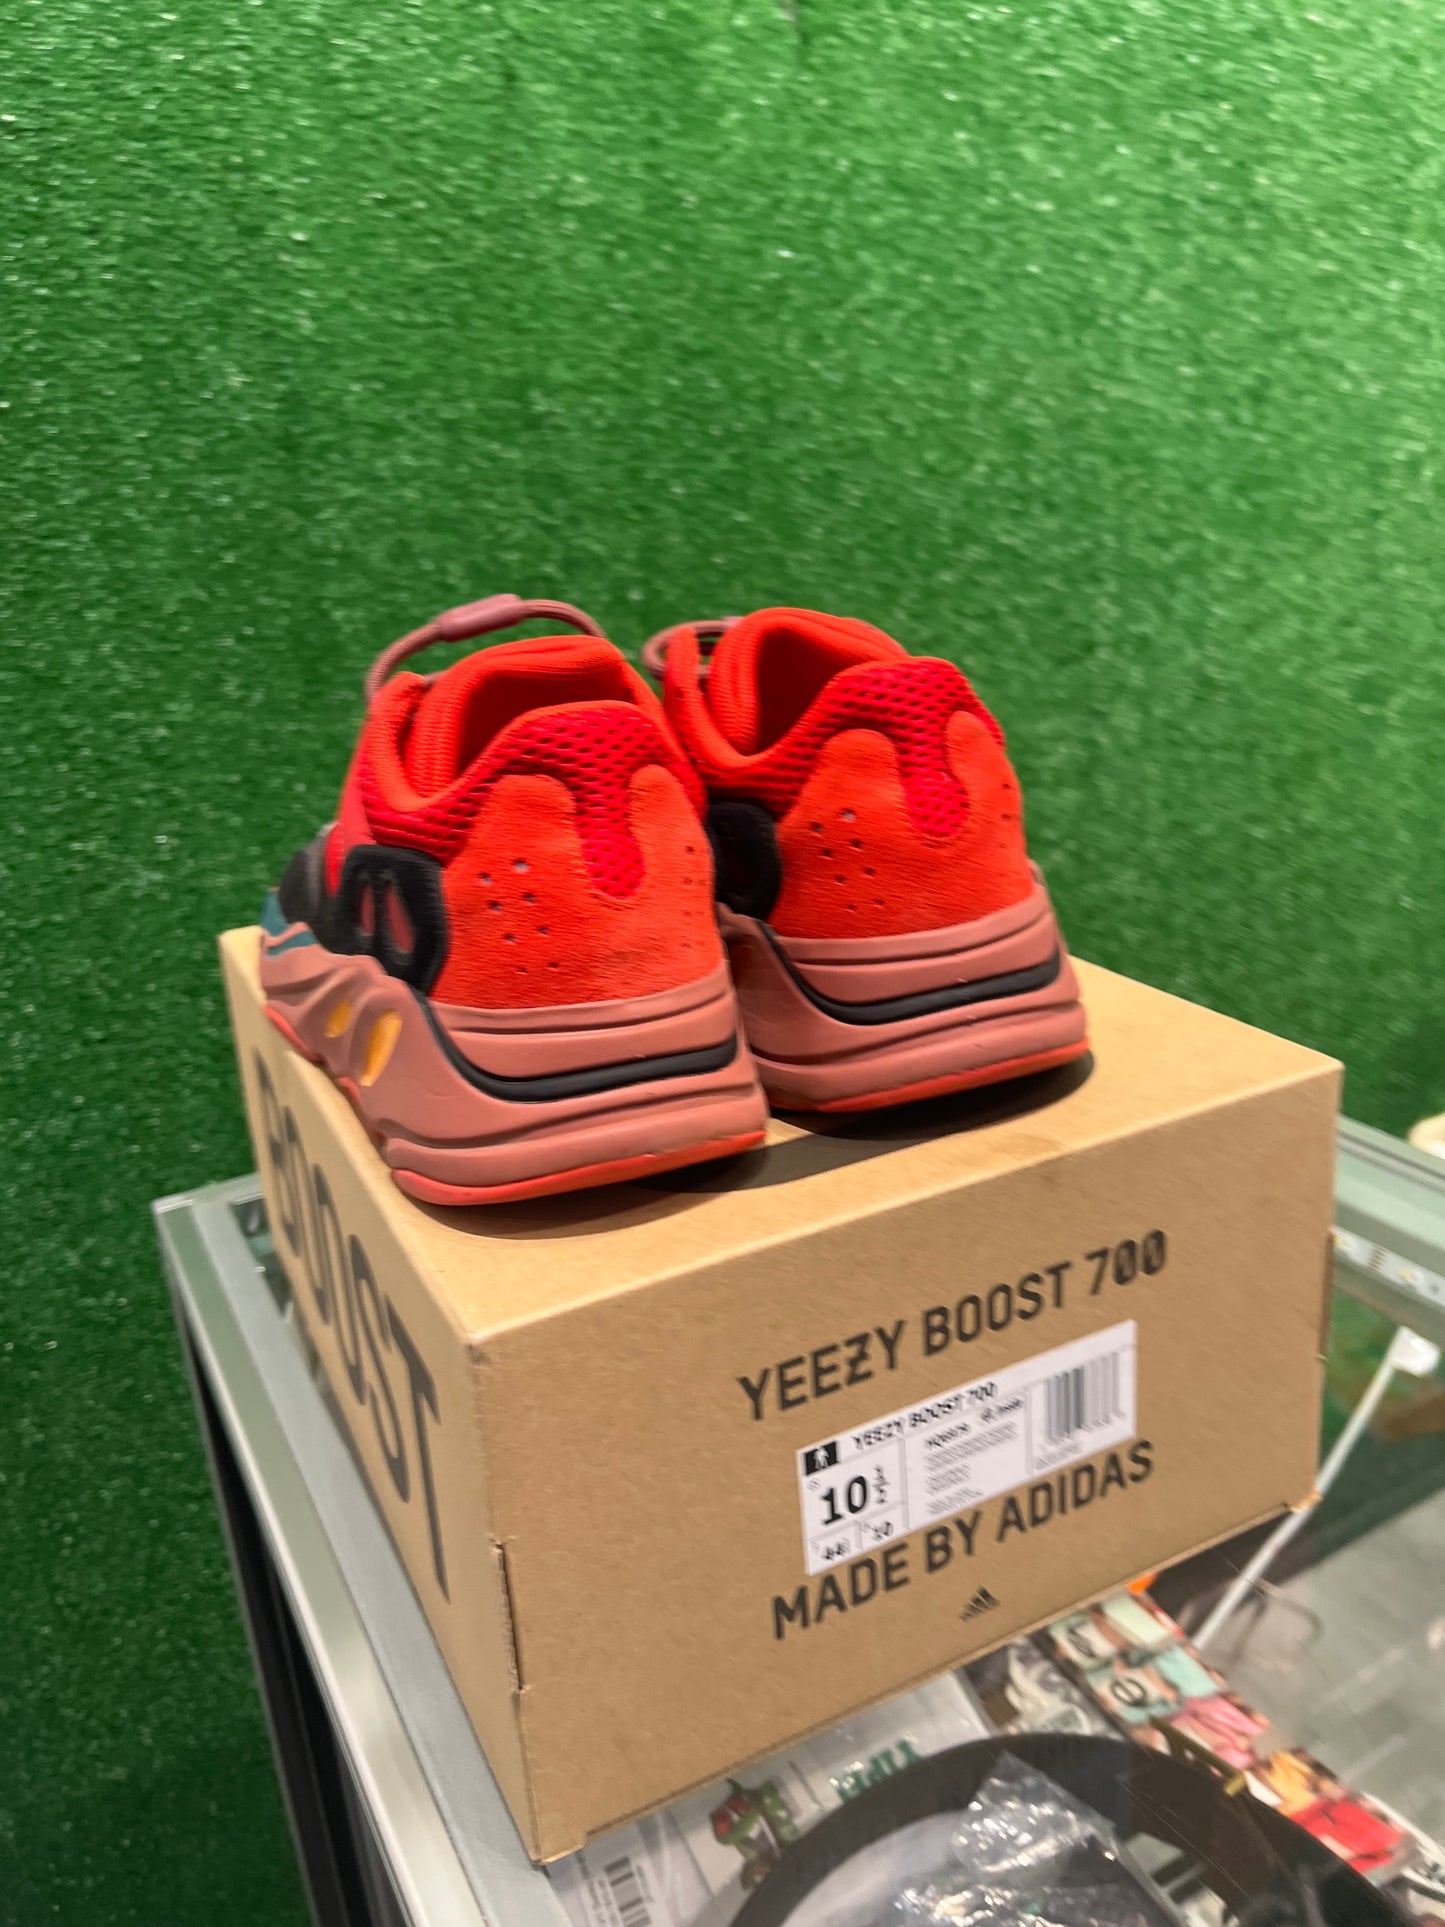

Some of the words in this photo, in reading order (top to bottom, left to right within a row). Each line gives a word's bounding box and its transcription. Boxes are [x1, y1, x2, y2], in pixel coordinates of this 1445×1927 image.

[254, 1045, 450, 1606] BOOST
[737, 1320, 906, 1420] YEEZY
[921, 1262, 1072, 1355] BOOST
[1085, 1229, 1168, 1296] 700
[772, 1543, 911, 1640] MADE
[925, 1511, 982, 1574] BY
[996, 1440, 1154, 1543] ADIDAS
[821, 1475, 867, 1525] 10
